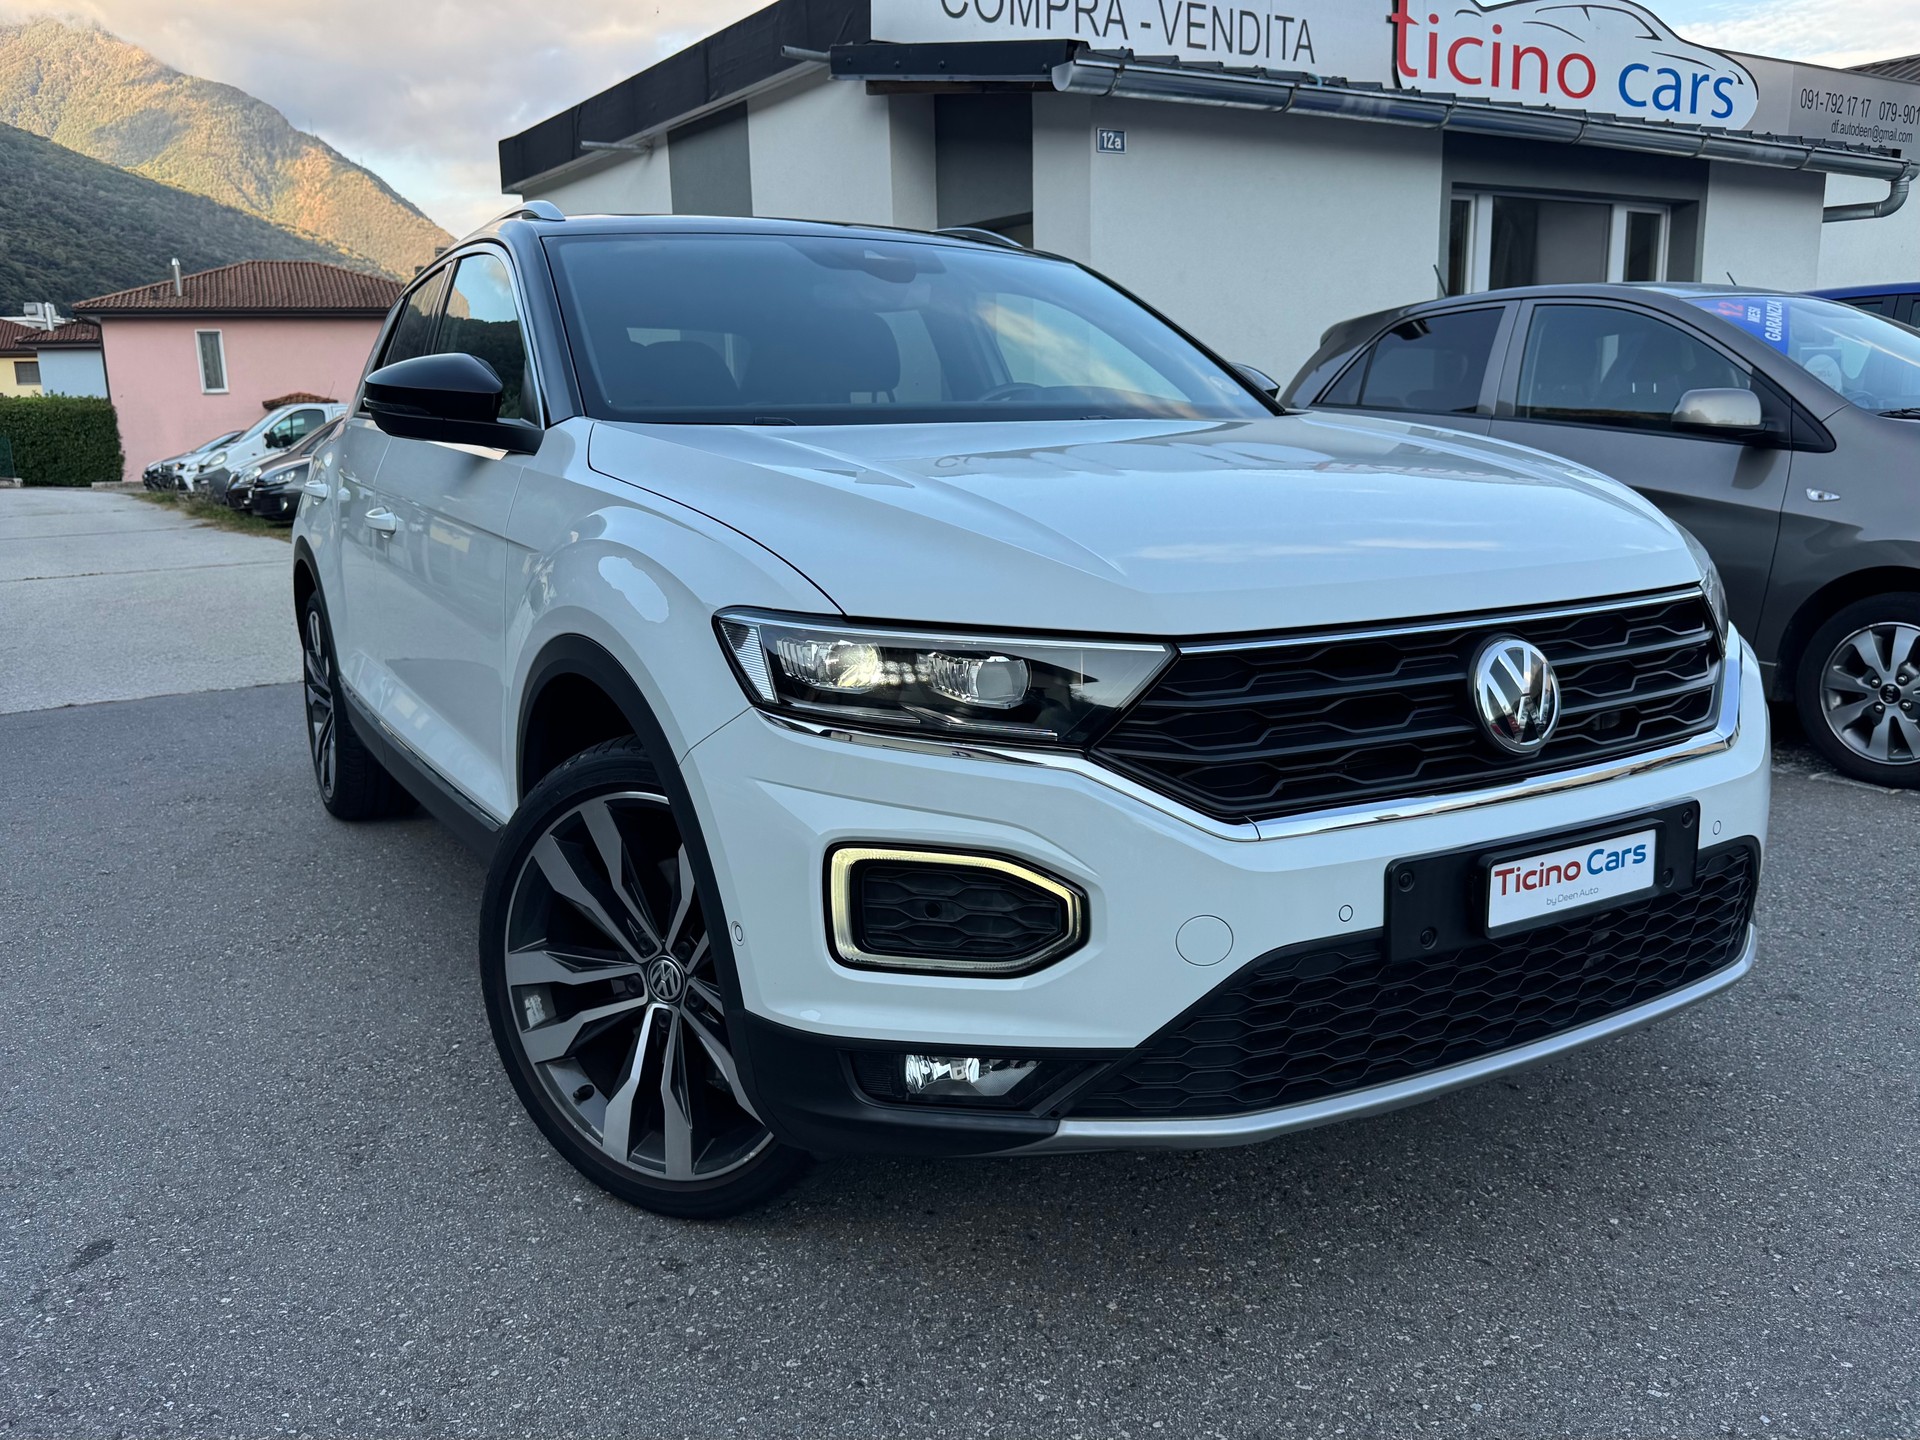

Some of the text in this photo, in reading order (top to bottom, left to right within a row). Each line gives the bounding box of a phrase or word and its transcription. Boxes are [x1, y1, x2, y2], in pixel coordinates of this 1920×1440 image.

[1158, 0, 1315, 64] VENDITA
[1391, 0, 1734, 119] ticino cars
[1800, 88, 1844, 114] 091-792
[1847, 95, 1858, 116] 17
[1861, 98, 1872, 118] 17
[1101, 132, 1122, 149] 12a
[1764, 299, 1783, 342] GARANZIA
[1885, 685, 1895, 702] KIA
[1494, 844, 1647, 896] Ticino Cars
[1546, 887, 1600, 906] by Deen Auto
